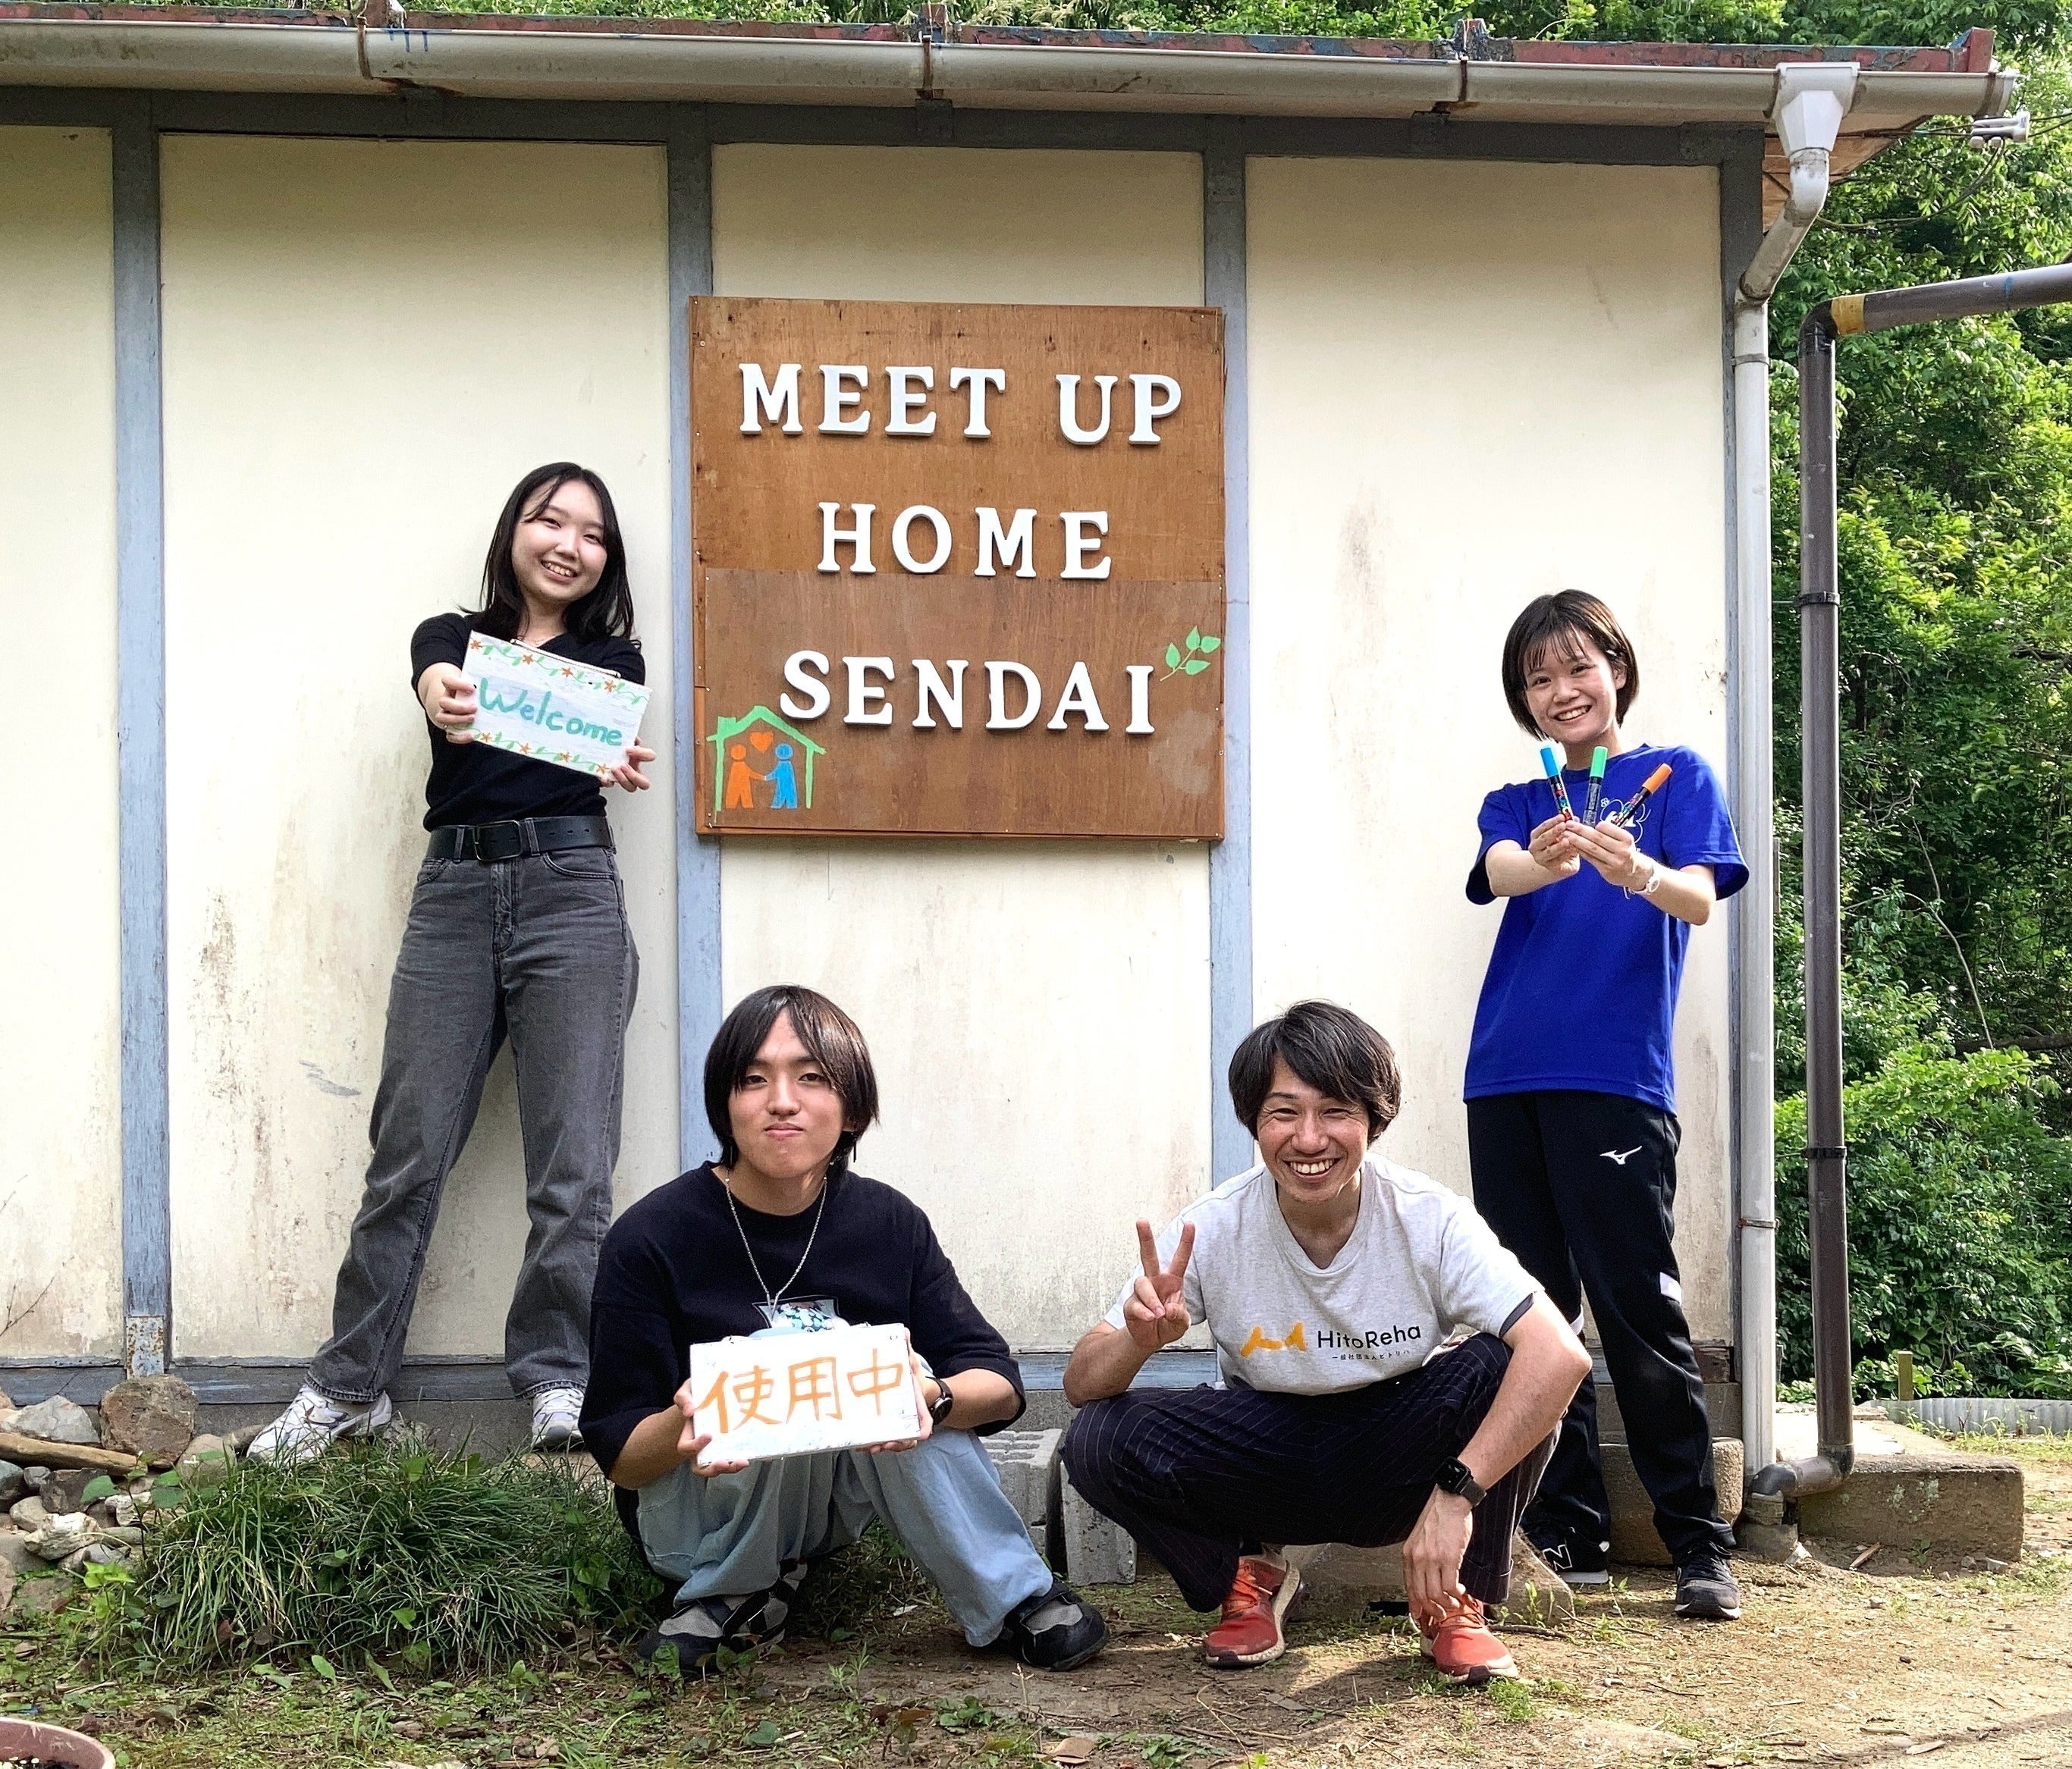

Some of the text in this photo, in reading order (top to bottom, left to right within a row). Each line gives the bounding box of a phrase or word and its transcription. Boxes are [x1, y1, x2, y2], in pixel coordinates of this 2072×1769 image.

[739, 363, 1182, 446] MEET UP
[817, 501, 1112, 579] HOME
[478, 677, 623, 747] Welcome
[780, 650, 1156, 734] SENDAI
[1317, 1325, 1421, 1349] HitoReha
[695, 1347, 904, 1434] 使用中
